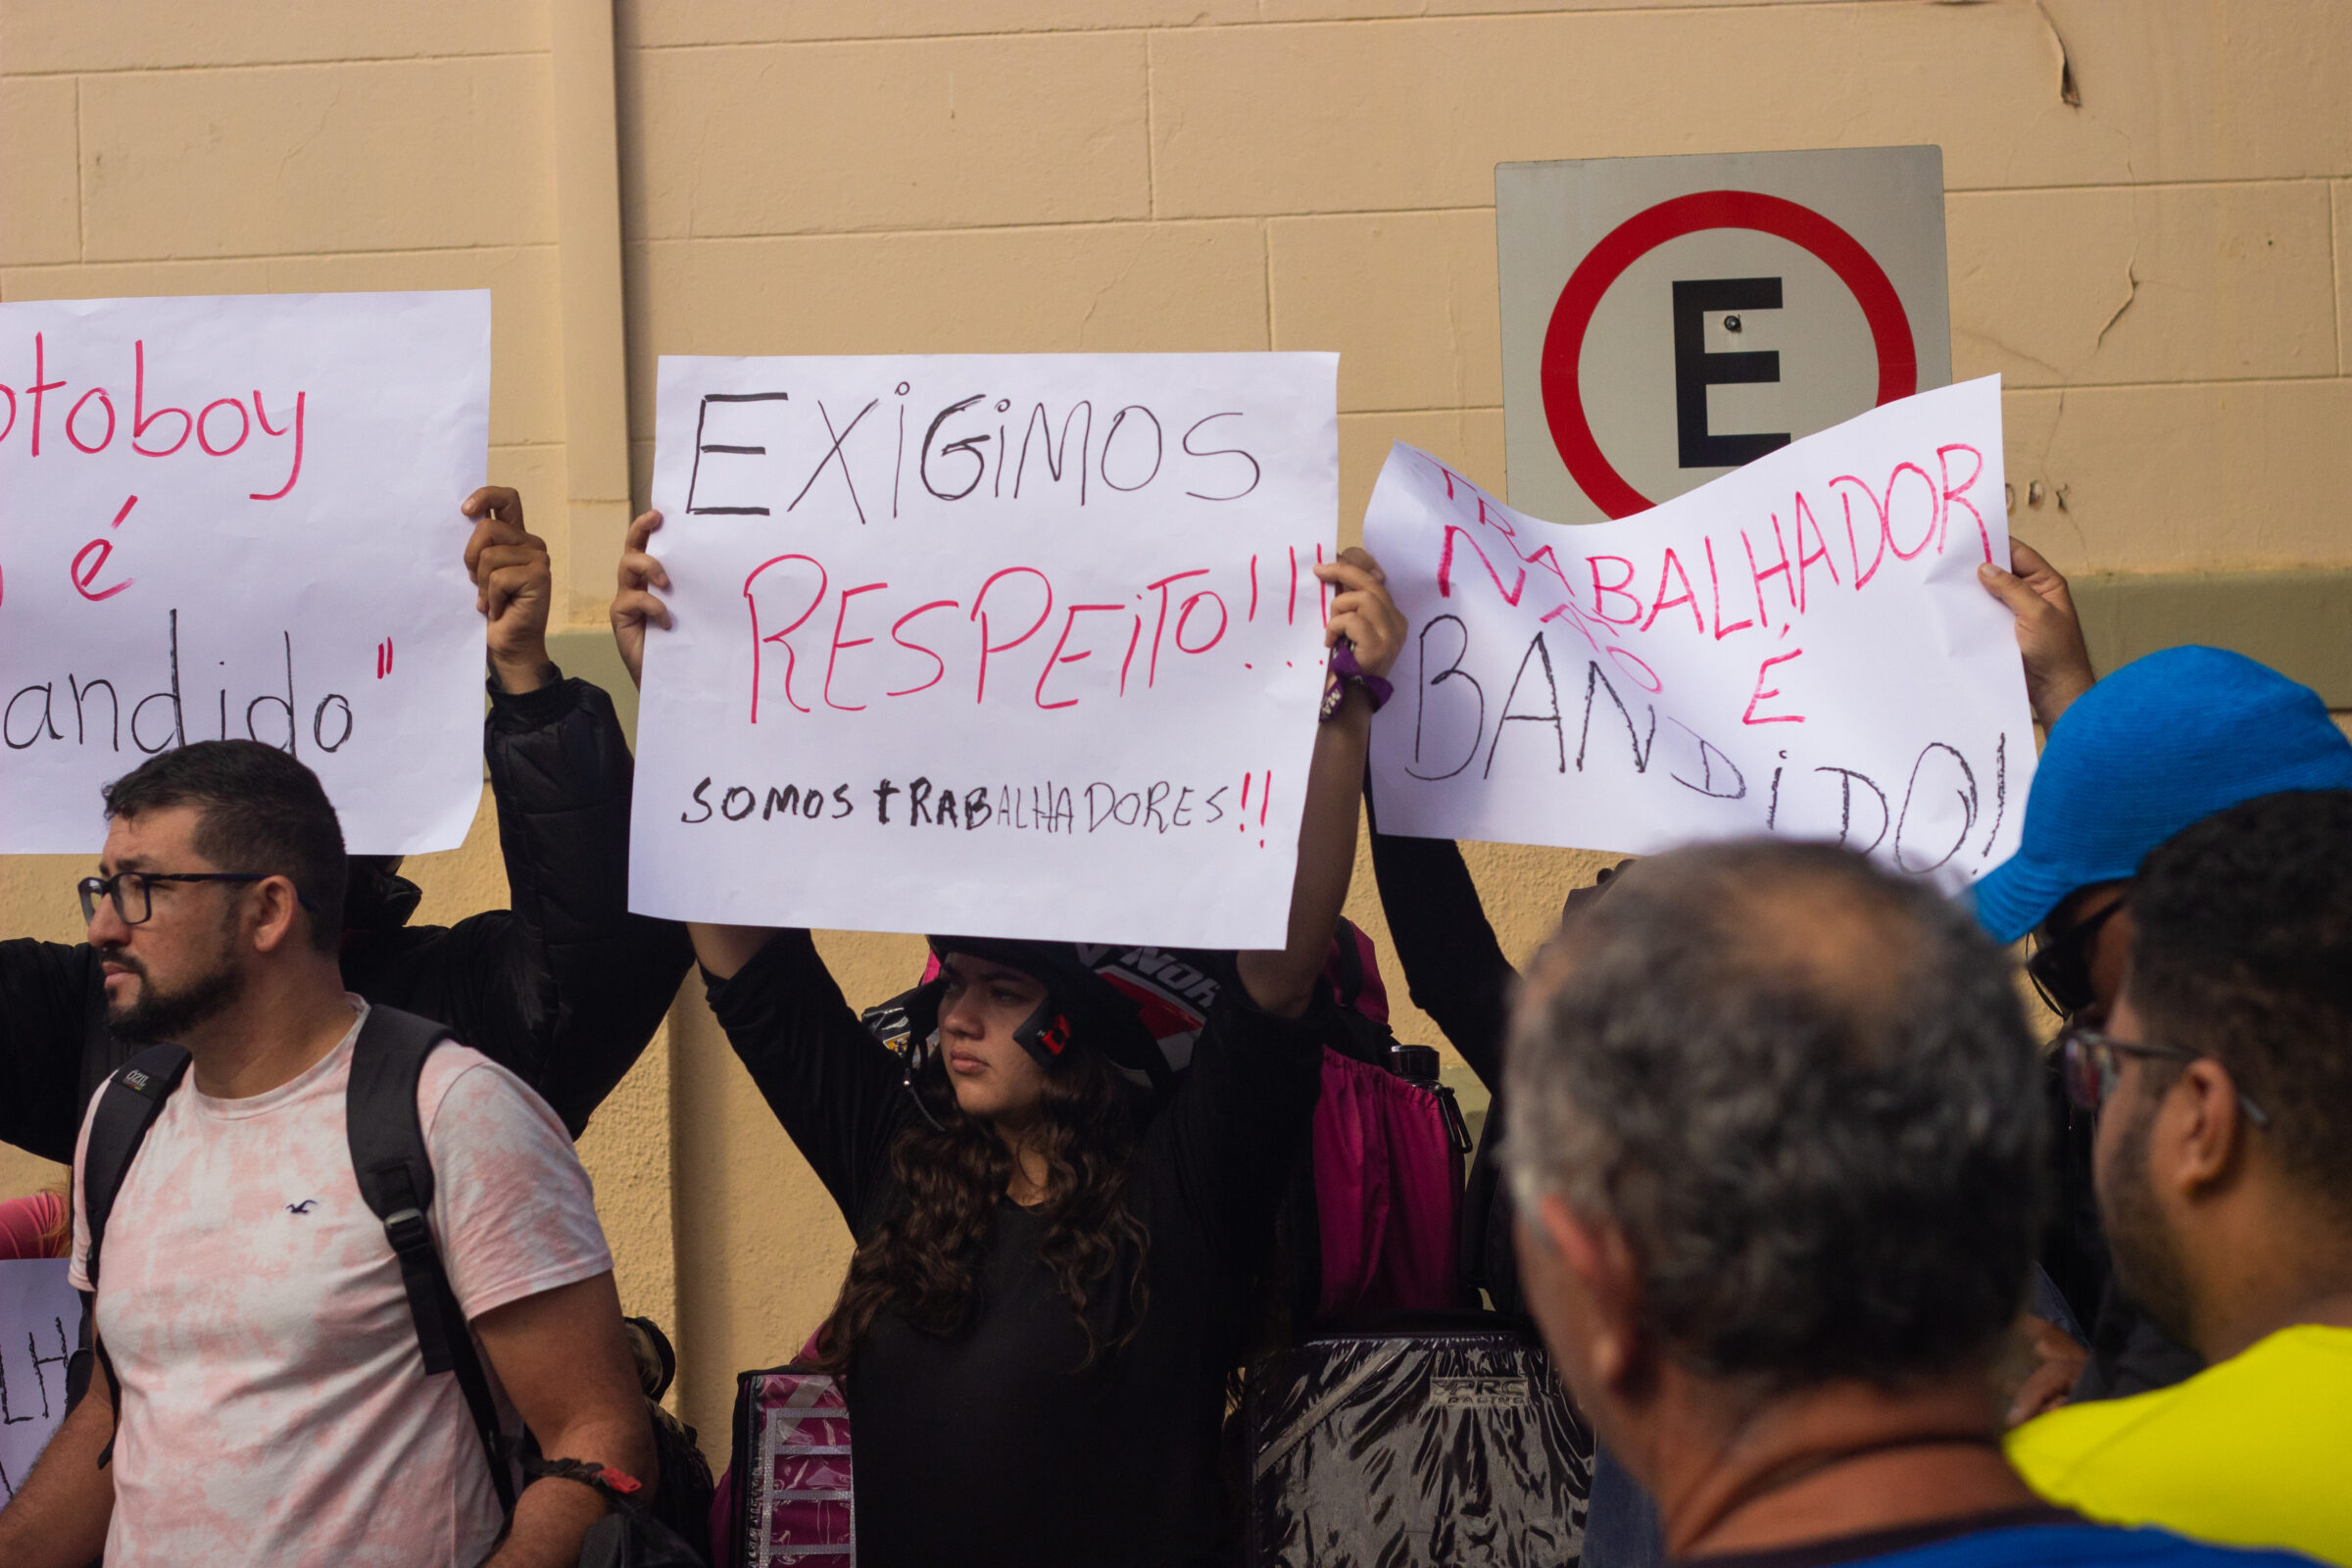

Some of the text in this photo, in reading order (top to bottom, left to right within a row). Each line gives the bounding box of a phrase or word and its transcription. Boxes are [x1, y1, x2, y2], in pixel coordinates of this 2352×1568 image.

[0, 331, 306, 500] toboy
[1671, 275, 1792, 469] E
[71, 495, 138, 602] é
[1415, 443, 1993, 641] TRABALHADOR
[1437, 524, 1805, 725] NÃO É
[680, 776, 854, 824] SOMOS
